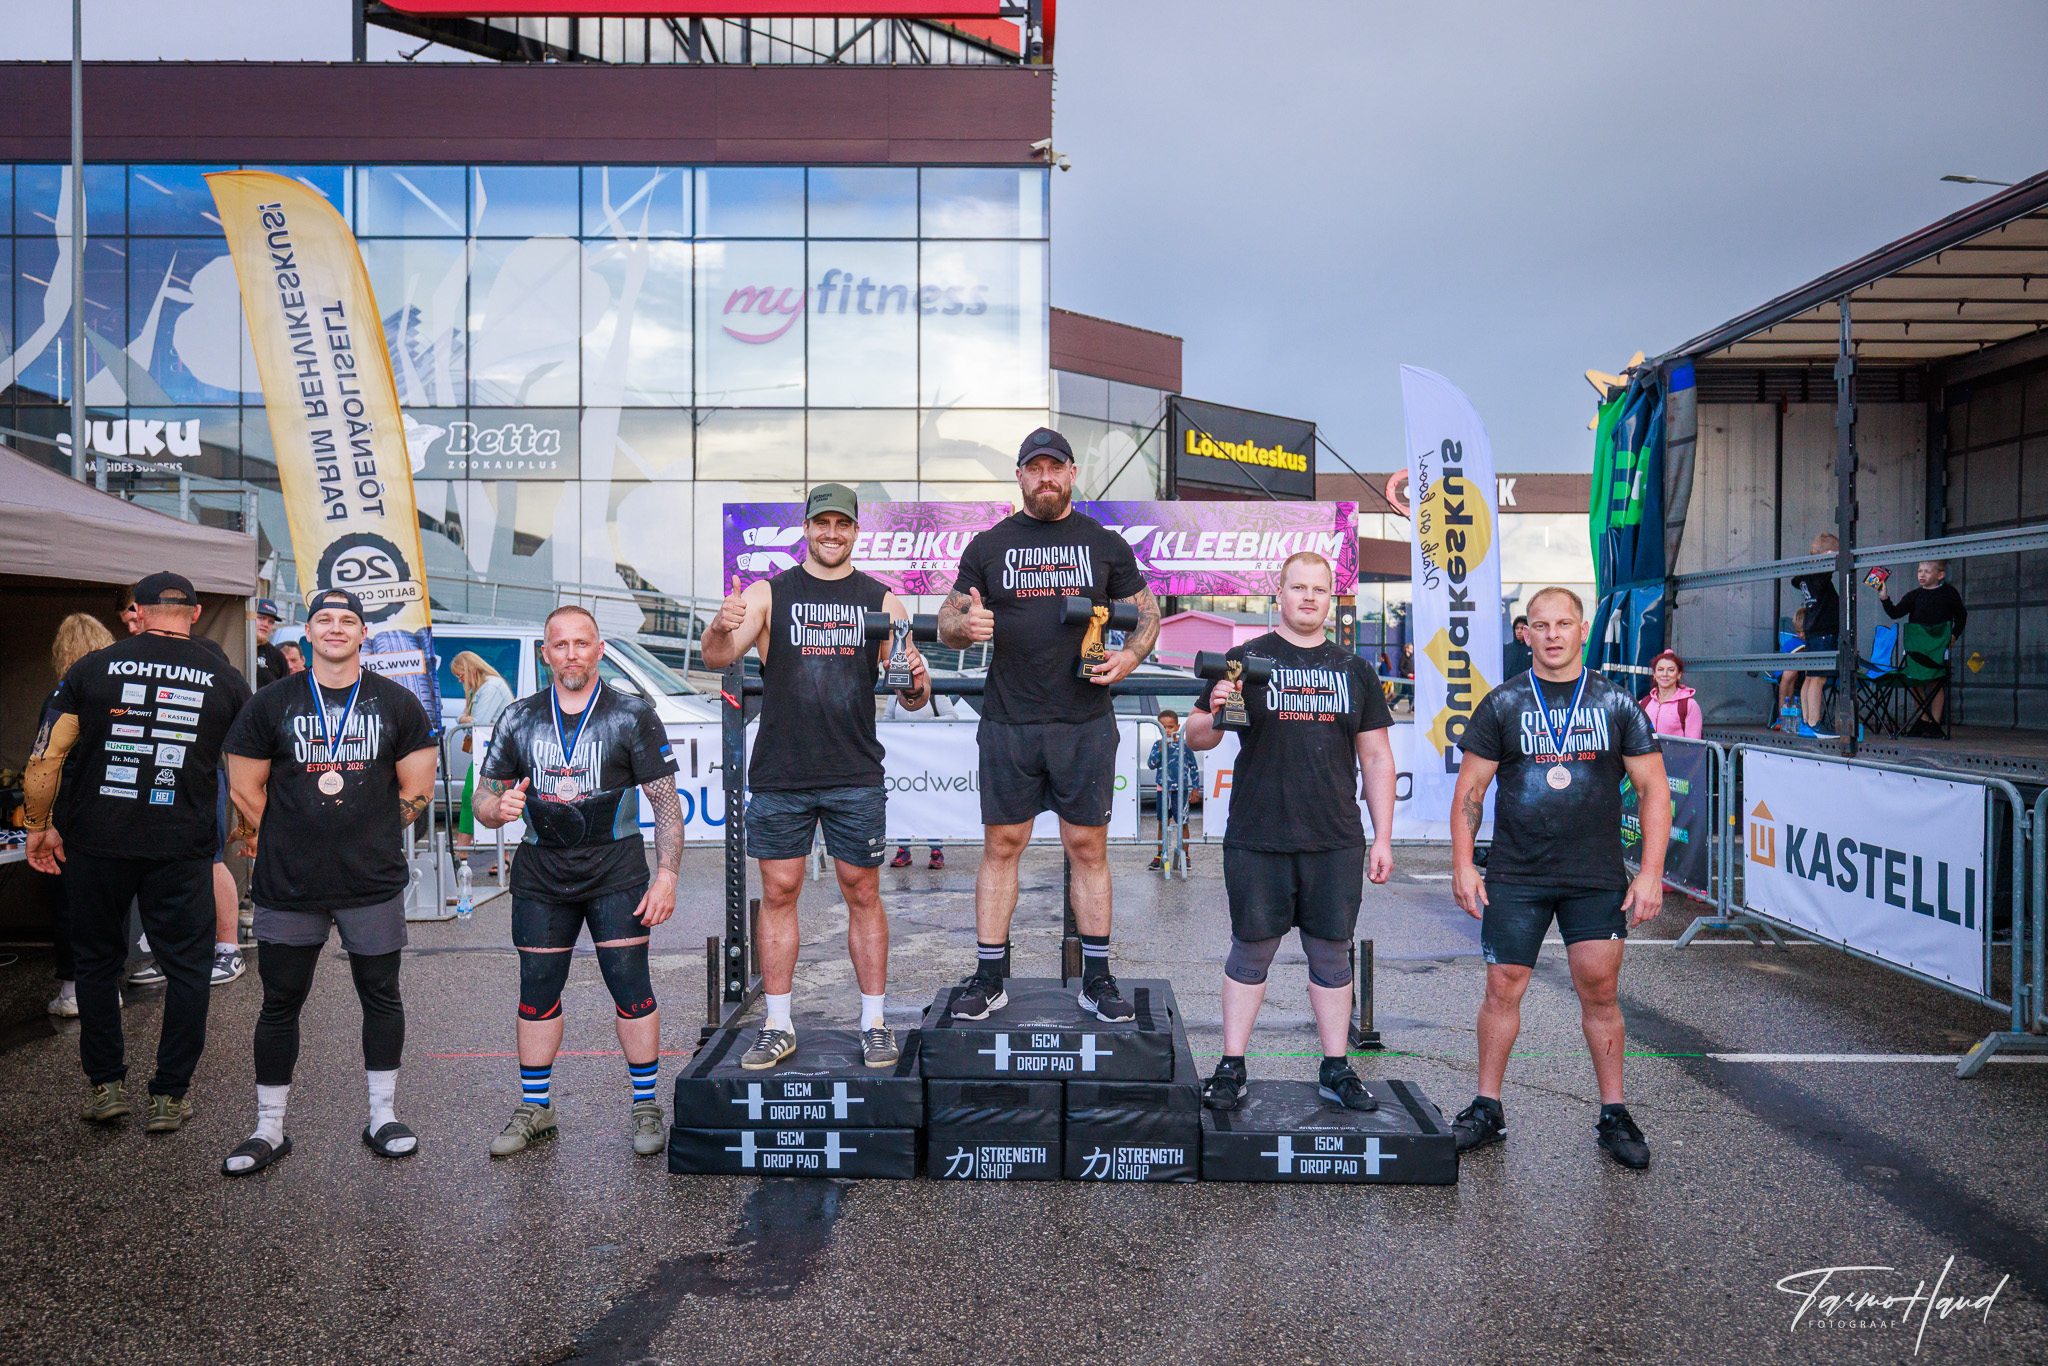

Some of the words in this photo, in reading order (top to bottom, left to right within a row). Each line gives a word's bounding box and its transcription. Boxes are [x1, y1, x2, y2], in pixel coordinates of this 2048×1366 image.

[56, 419, 202, 457] JUKU
[446, 422, 560, 456] Betta
[1185, 429, 1308, 472] Lõunakeskus
[448, 461, 558, 470] ZOOKAUPLUS
[851, 531, 981, 559] EEBIKU
[1151, 531, 1346, 559] KLEEBIKUM
[1016, 588, 1056, 598] ESTONIA
[1061, 588, 1080, 596] 2026
[801, 646, 836, 656] ESTONIA
[839, 647, 855, 656] 2026
[108, 661, 214, 687] KOHTUNIK
[1301, 687, 1316, 695] PRO
[167, 714, 195, 722] KASTELLI
[1278, 711, 1315, 721] ESTONIA
[1318, 713, 1335, 722] 2026
[1577, 751, 1597, 761] 2026
[306, 762, 343, 773] ESTONIA
[346, 761, 364, 771] 2026
[1785, 823, 1976, 931] KASTELLI
[1031, 1034, 1060, 1049] 15CM
[1016, 1056, 1048, 1071] DROP
[1050, 1056, 1074, 1071] PAD
[783, 1082, 812, 1097] 15CM
[770, 1105, 801, 1120] DROP
[803, 1105, 826, 1120] PAD
[776, 1131, 805, 1146] 15CM
[1314, 1136, 1344, 1151] 15CM
[763, 1154, 794, 1168] DROP
[796, 1154, 819, 1169] PAD
[980, 1147, 1047, 1163] STRENGTH
[1117, 1147, 1184, 1165] STRENGTH
[980, 1163, 1013, 1179] SHOP
[1117, 1163, 1150, 1180] SHOP
[1299, 1159, 1332, 1175] DROP
[1334, 1159, 1358, 1175] PAD
